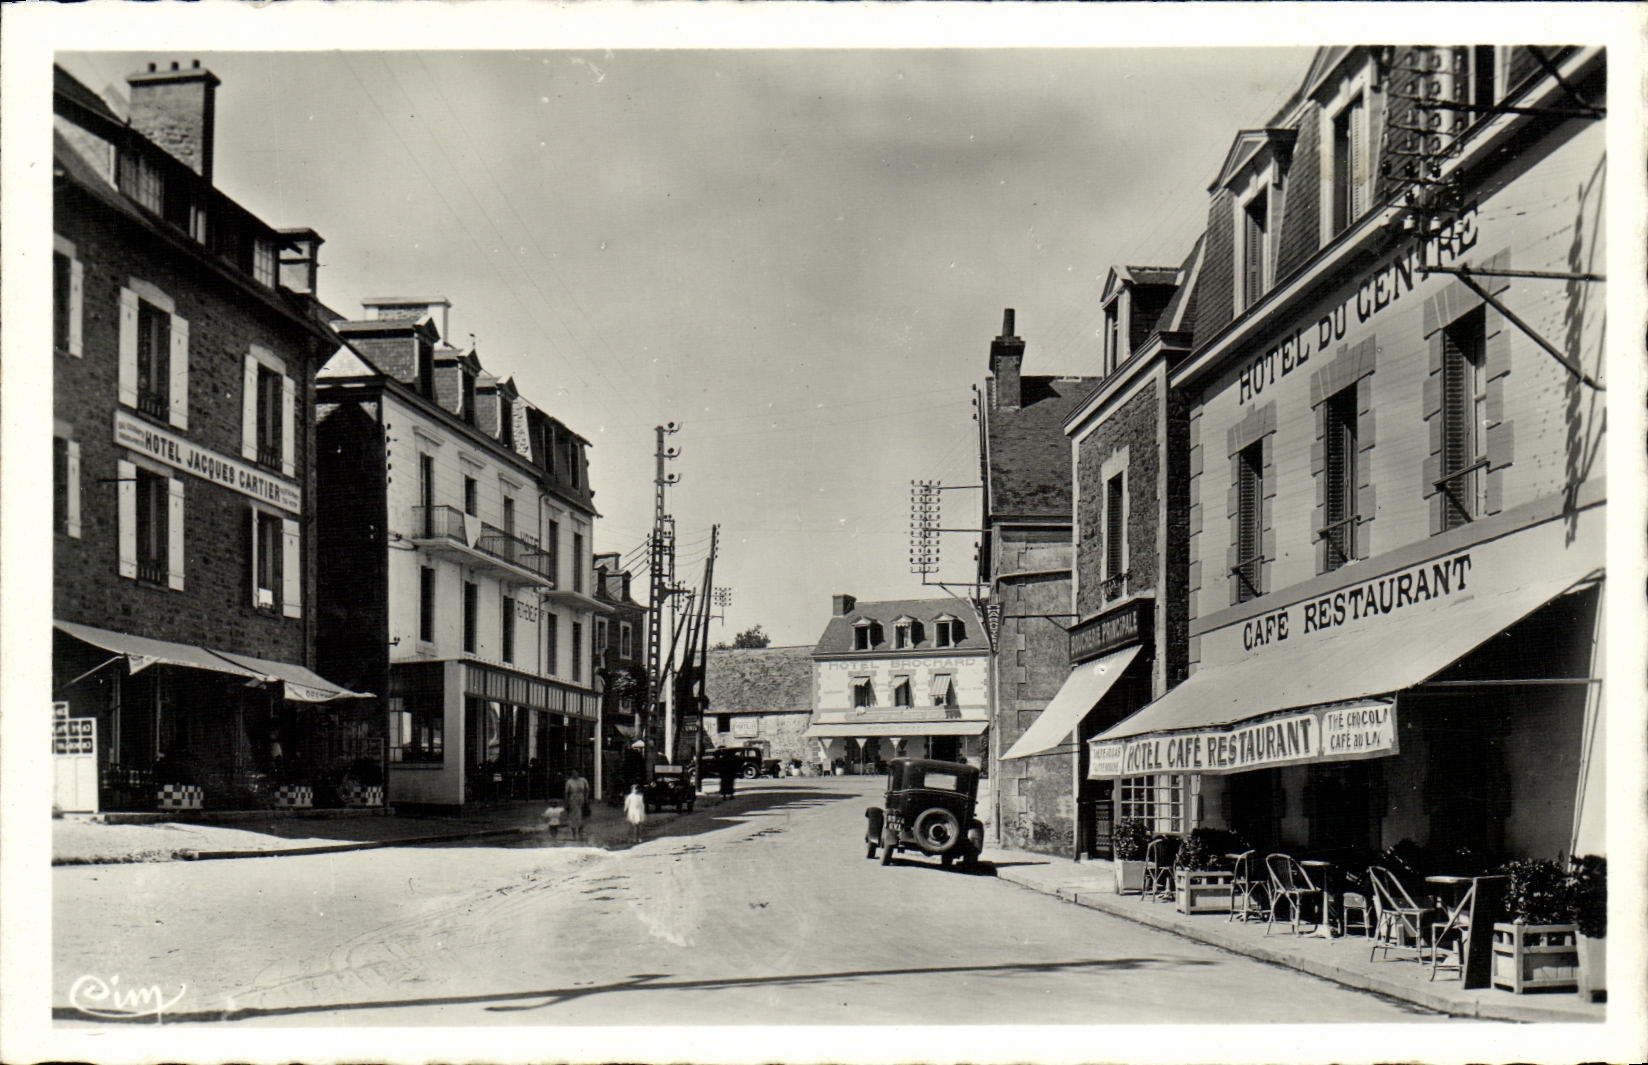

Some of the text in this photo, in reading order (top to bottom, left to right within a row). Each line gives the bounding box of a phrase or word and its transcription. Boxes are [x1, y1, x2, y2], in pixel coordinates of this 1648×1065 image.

[1239, 327, 1310, 405] HOTEL
[1318, 302, 1347, 352] DU
[145, 430, 182, 465] HOTEL
[187, 449, 235, 484] JACQUES
[239, 470, 280, 501] CARTIER
[1243, 553, 1472, 651] CAFÉ RESTAURANT
[828, 657, 976, 671] HOTEL BROCHARD
[1167, 734, 1202, 768] CAFÉ
[1207, 717, 1311, 767] RESTAURANT
